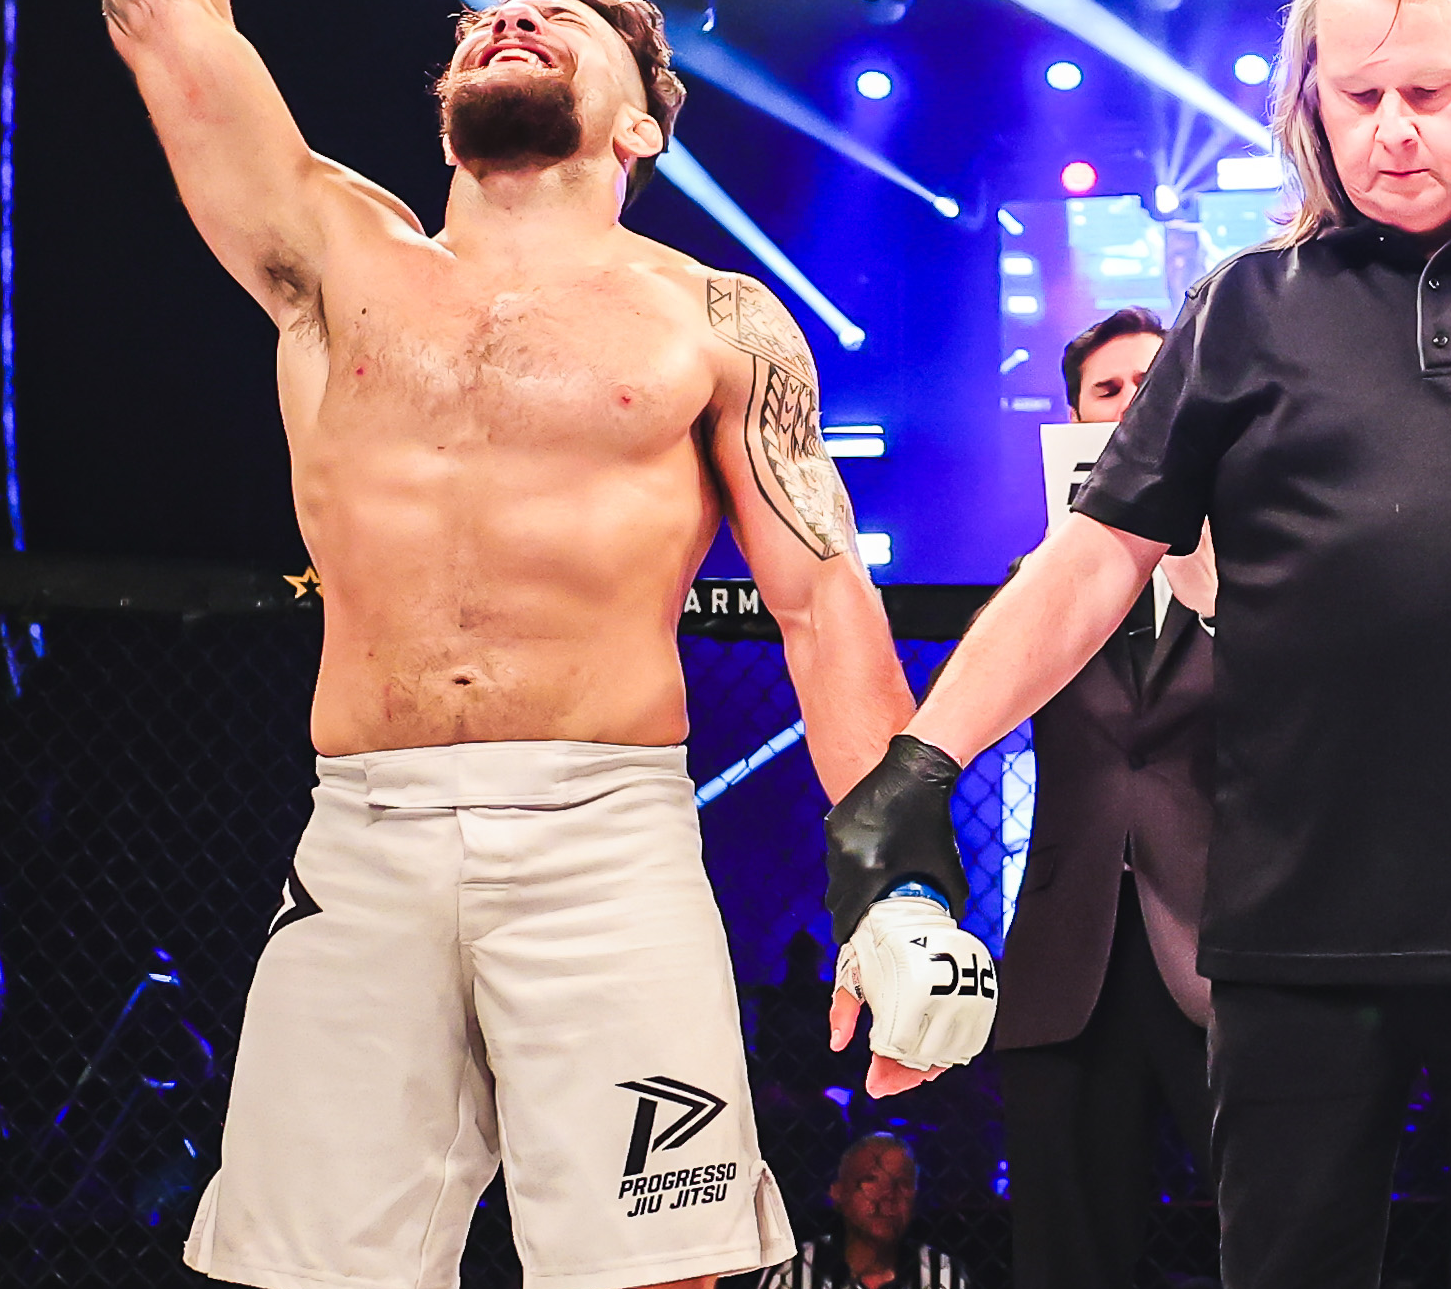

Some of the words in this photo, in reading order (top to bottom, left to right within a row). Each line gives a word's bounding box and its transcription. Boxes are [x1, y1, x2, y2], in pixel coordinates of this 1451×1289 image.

[684, 588, 759, 613] ARM
[929, 952, 996, 1000] PFC
[618, 1162, 737, 1200] PROGRESSO
[627, 1194, 663, 1218] JIU
[669, 1183, 728, 1210] JITSU
